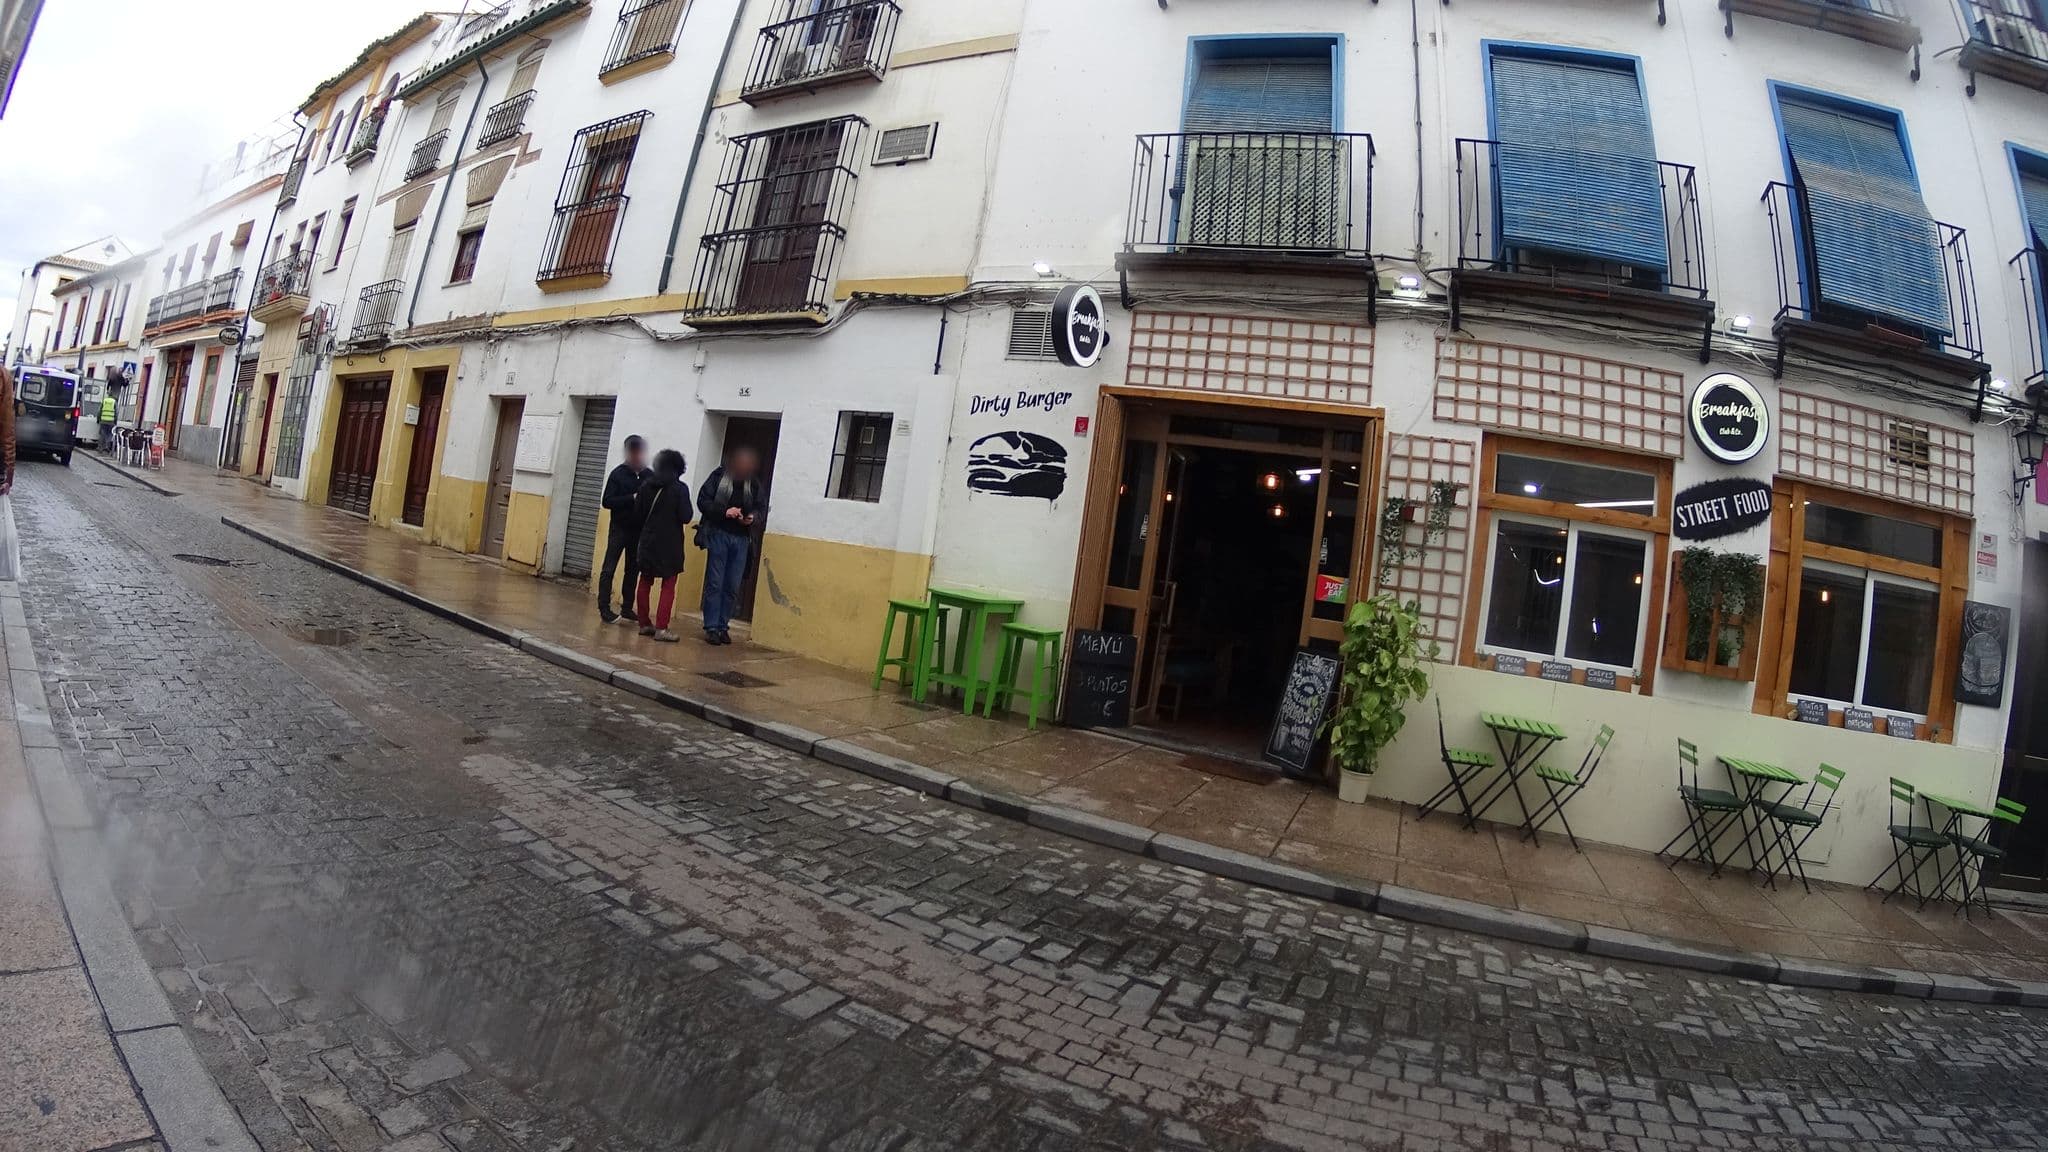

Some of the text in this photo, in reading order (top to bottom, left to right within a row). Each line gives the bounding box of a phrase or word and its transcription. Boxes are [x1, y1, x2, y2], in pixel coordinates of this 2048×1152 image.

[970, 391, 1073, 417] Dirty Burger
[1676, 489, 1769, 528] STREET FOOD
[1324, 582, 1343, 590] JUST
